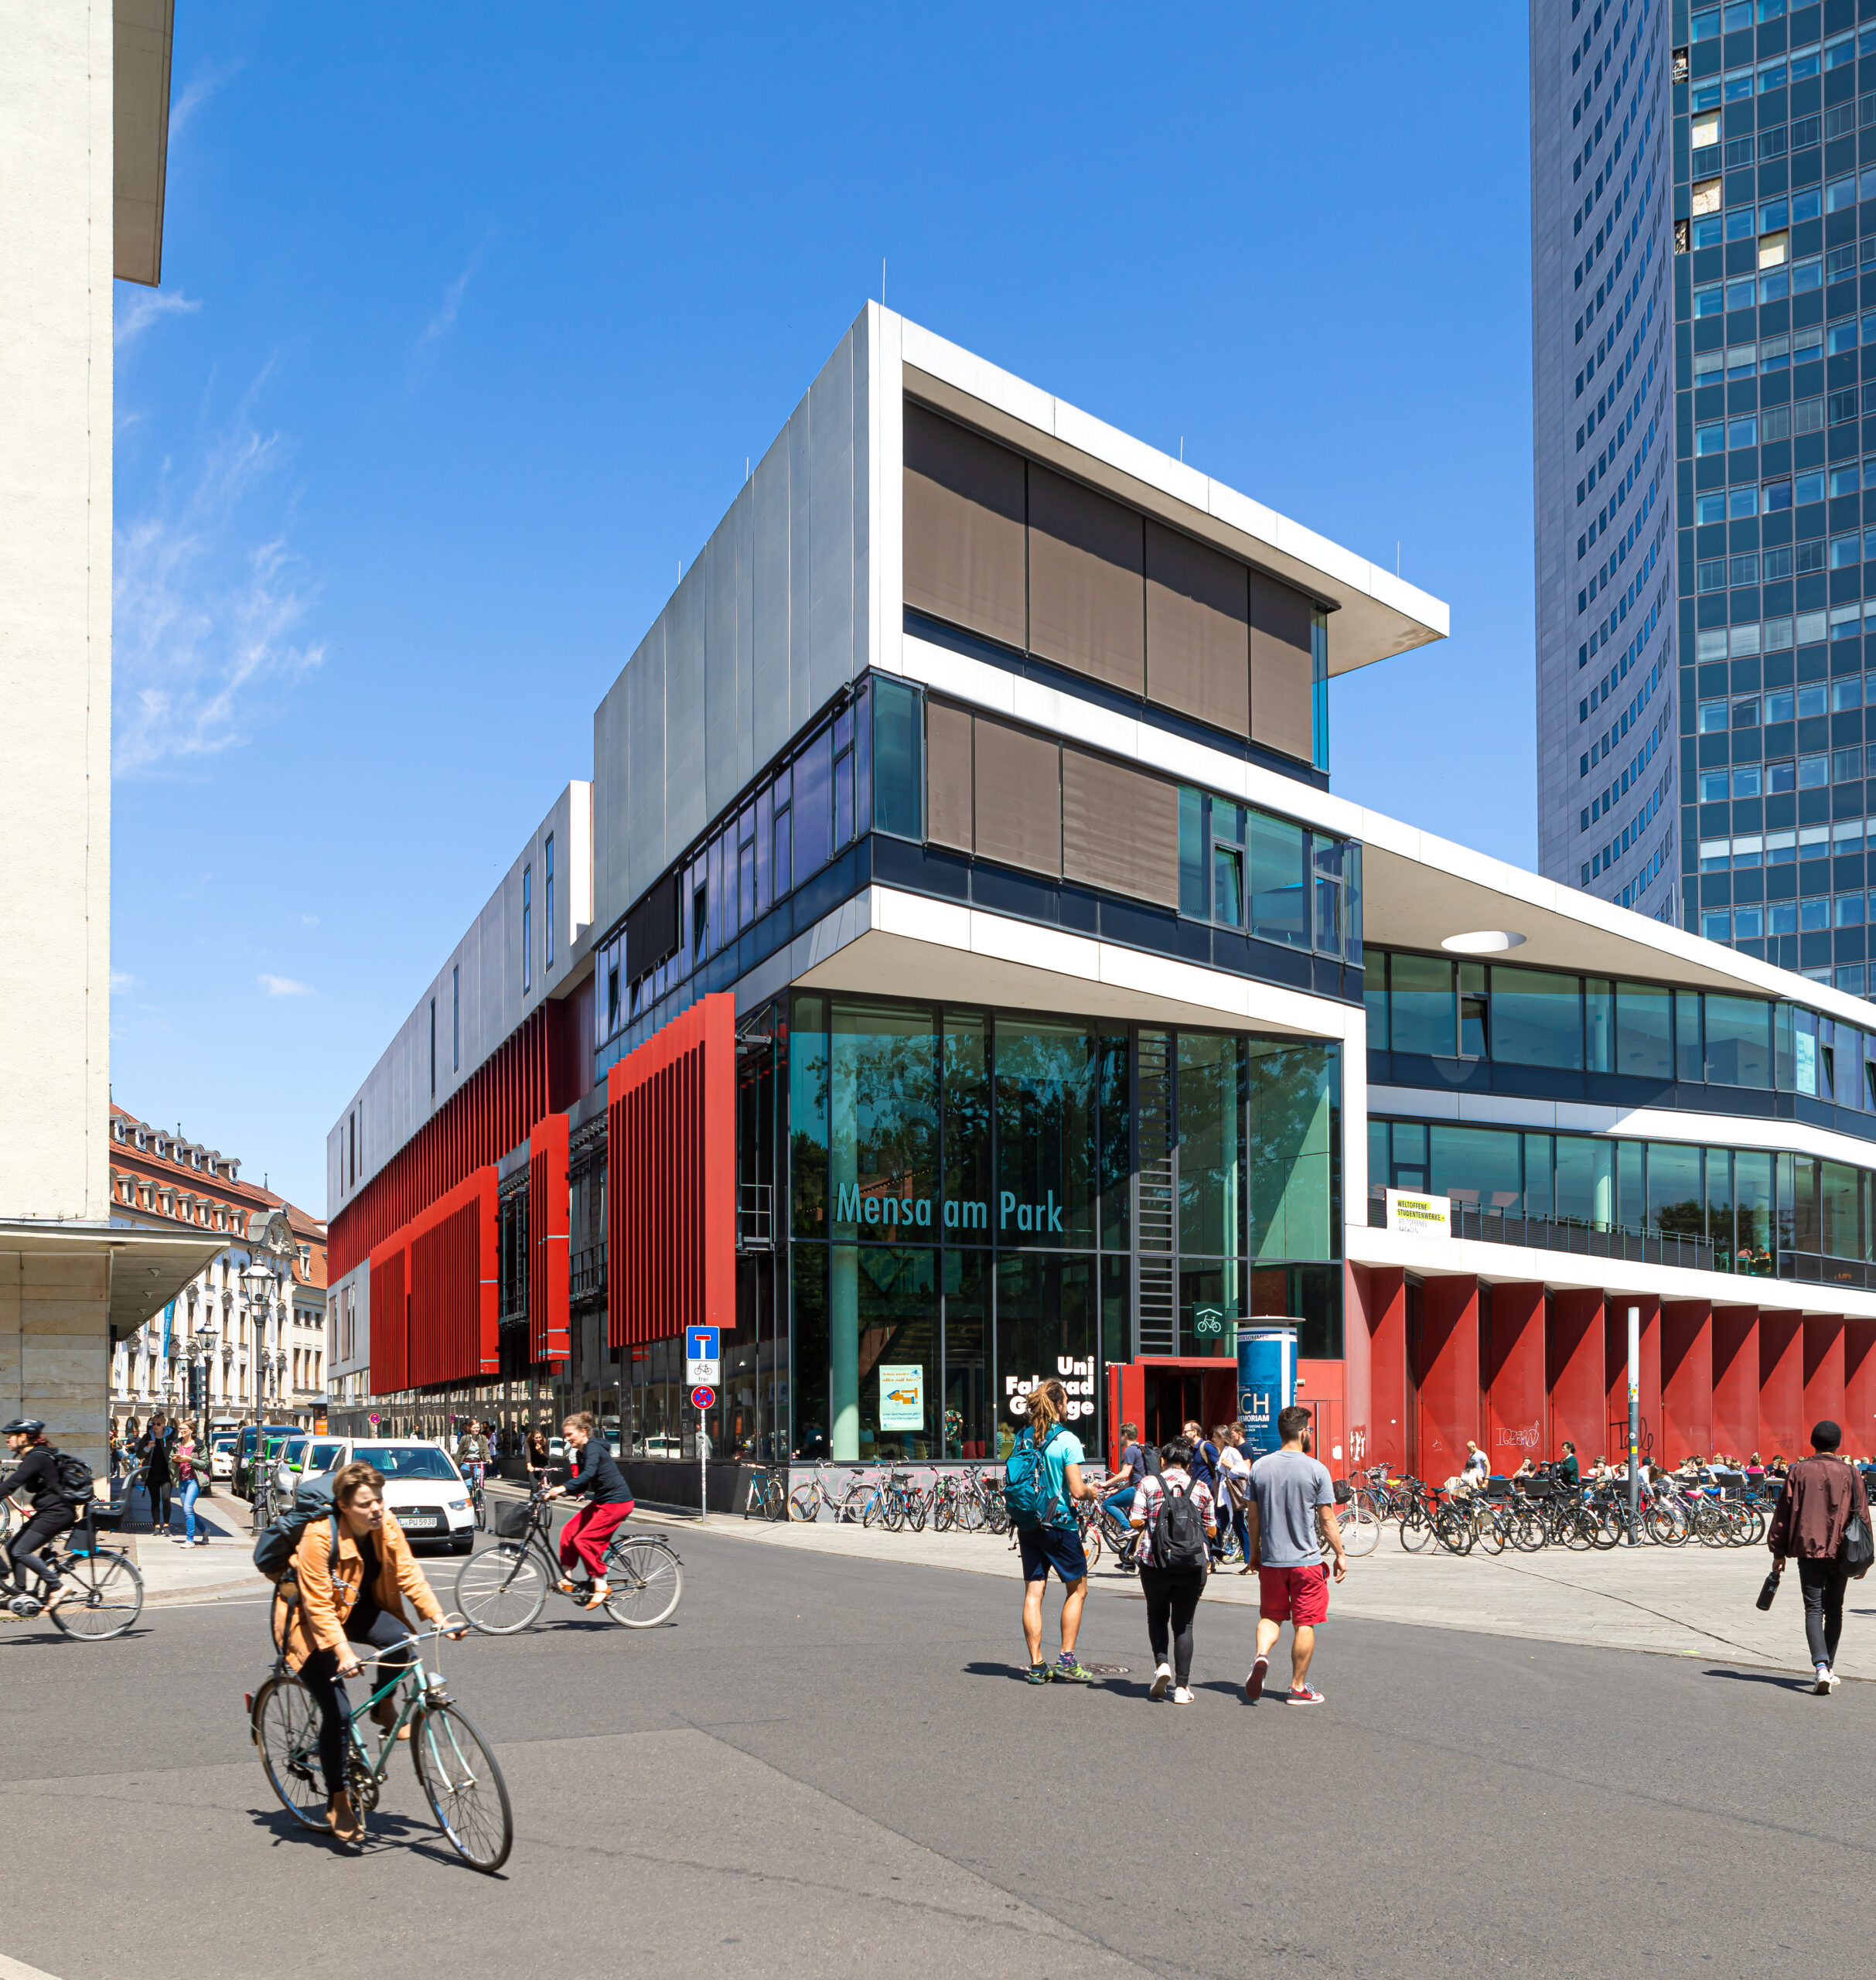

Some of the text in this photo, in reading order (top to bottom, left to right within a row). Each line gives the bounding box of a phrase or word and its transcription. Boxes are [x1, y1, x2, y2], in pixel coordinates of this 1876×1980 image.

[836, 1182, 1063, 1232] Mensa am Park
[1397, 1200, 1427, 1210] WELTOFFENE
[1397, 1209, 1441, 1221] STUDENTENWERKE
[1057, 1356, 1094, 1375] Uni
[1009, 1395, 1094, 1420] Gge
